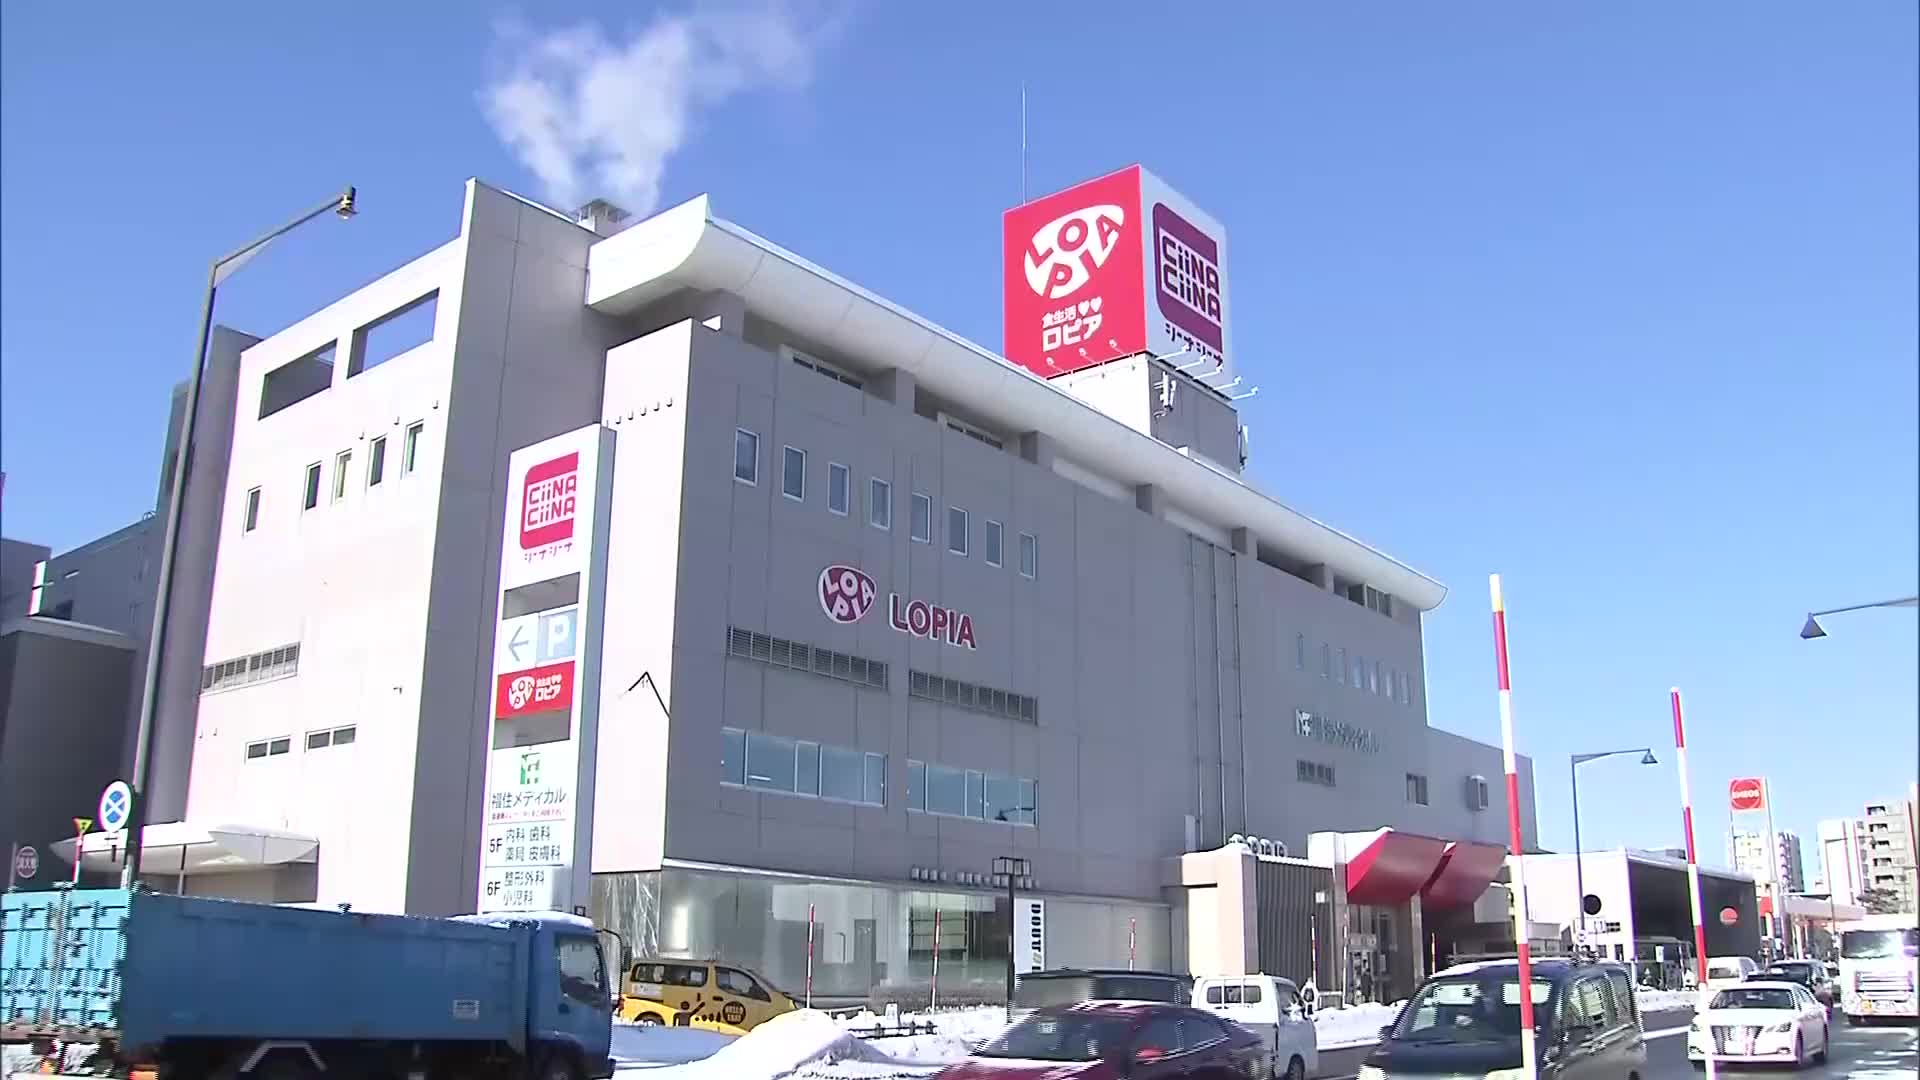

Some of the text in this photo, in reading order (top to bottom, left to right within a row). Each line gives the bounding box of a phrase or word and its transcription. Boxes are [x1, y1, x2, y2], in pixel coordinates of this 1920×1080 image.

[1162, 235, 1220, 295] CiiNA
[1163, 263, 1221, 322] CiiNA
[1042, 304, 1077, 329] 食生活
[1042, 313, 1102, 352] ロピア
[1165, 322, 1223, 367] シーナシーナ
[529, 475, 577, 505] CiiNA
[527, 496, 576, 526] CiiNA
[524, 542, 573, 564] シーナシーナ
[821, 566, 876, 622] LOPIA
[889, 593, 976, 650] LOPIA
[547, 615, 570, 656] P
[535, 685, 561, 702] ロピア
[492, 787, 567, 809] 福住メディカル
[489, 838, 503, 853] 5F
[506, 826, 550, 843] 内科 歯科
[505, 845, 561, 862] 薬局 皮膚科
[487, 881, 501, 896] 6F
[504, 870, 545, 887] 整形外科
[503, 890, 533, 906] 小児科
